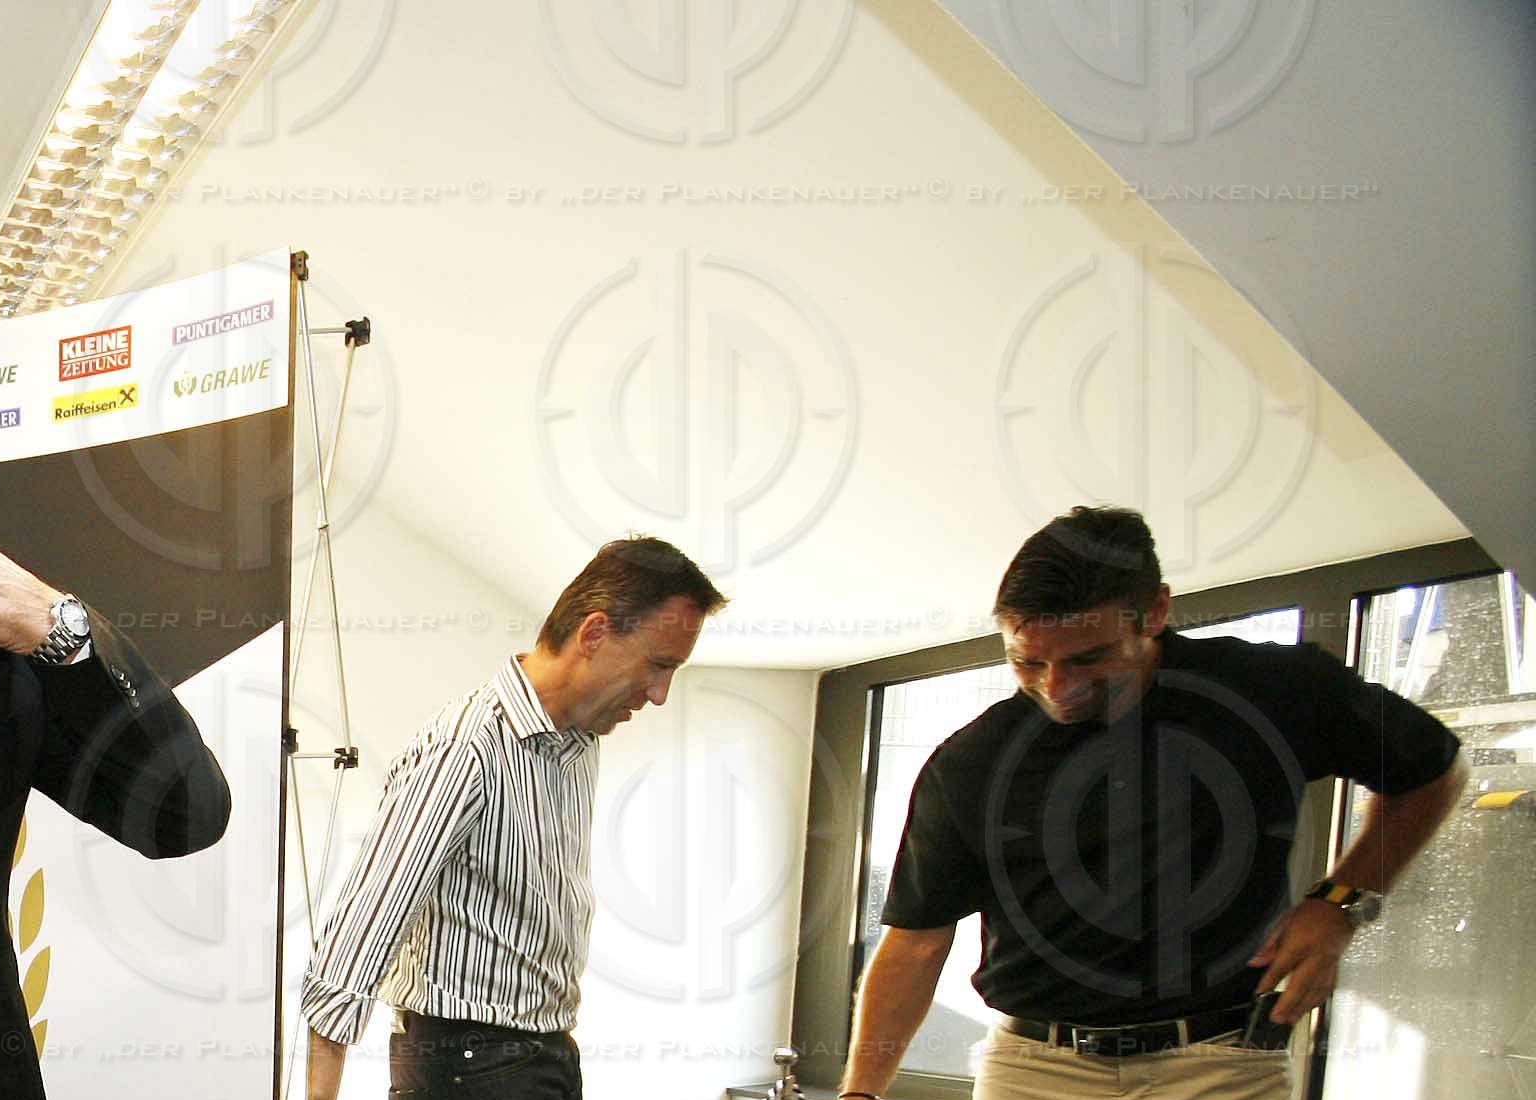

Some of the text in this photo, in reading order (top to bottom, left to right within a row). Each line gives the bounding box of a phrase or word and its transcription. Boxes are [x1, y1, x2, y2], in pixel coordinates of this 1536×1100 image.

[175, 304, 272, 345] PUNTIGAMER
[60, 329, 130, 362] KLEINE
[61, 350, 131, 380] ZEITUNG
[200, 359, 272, 394] GRAWE
[53, 398, 117, 421] Raiffeisen
